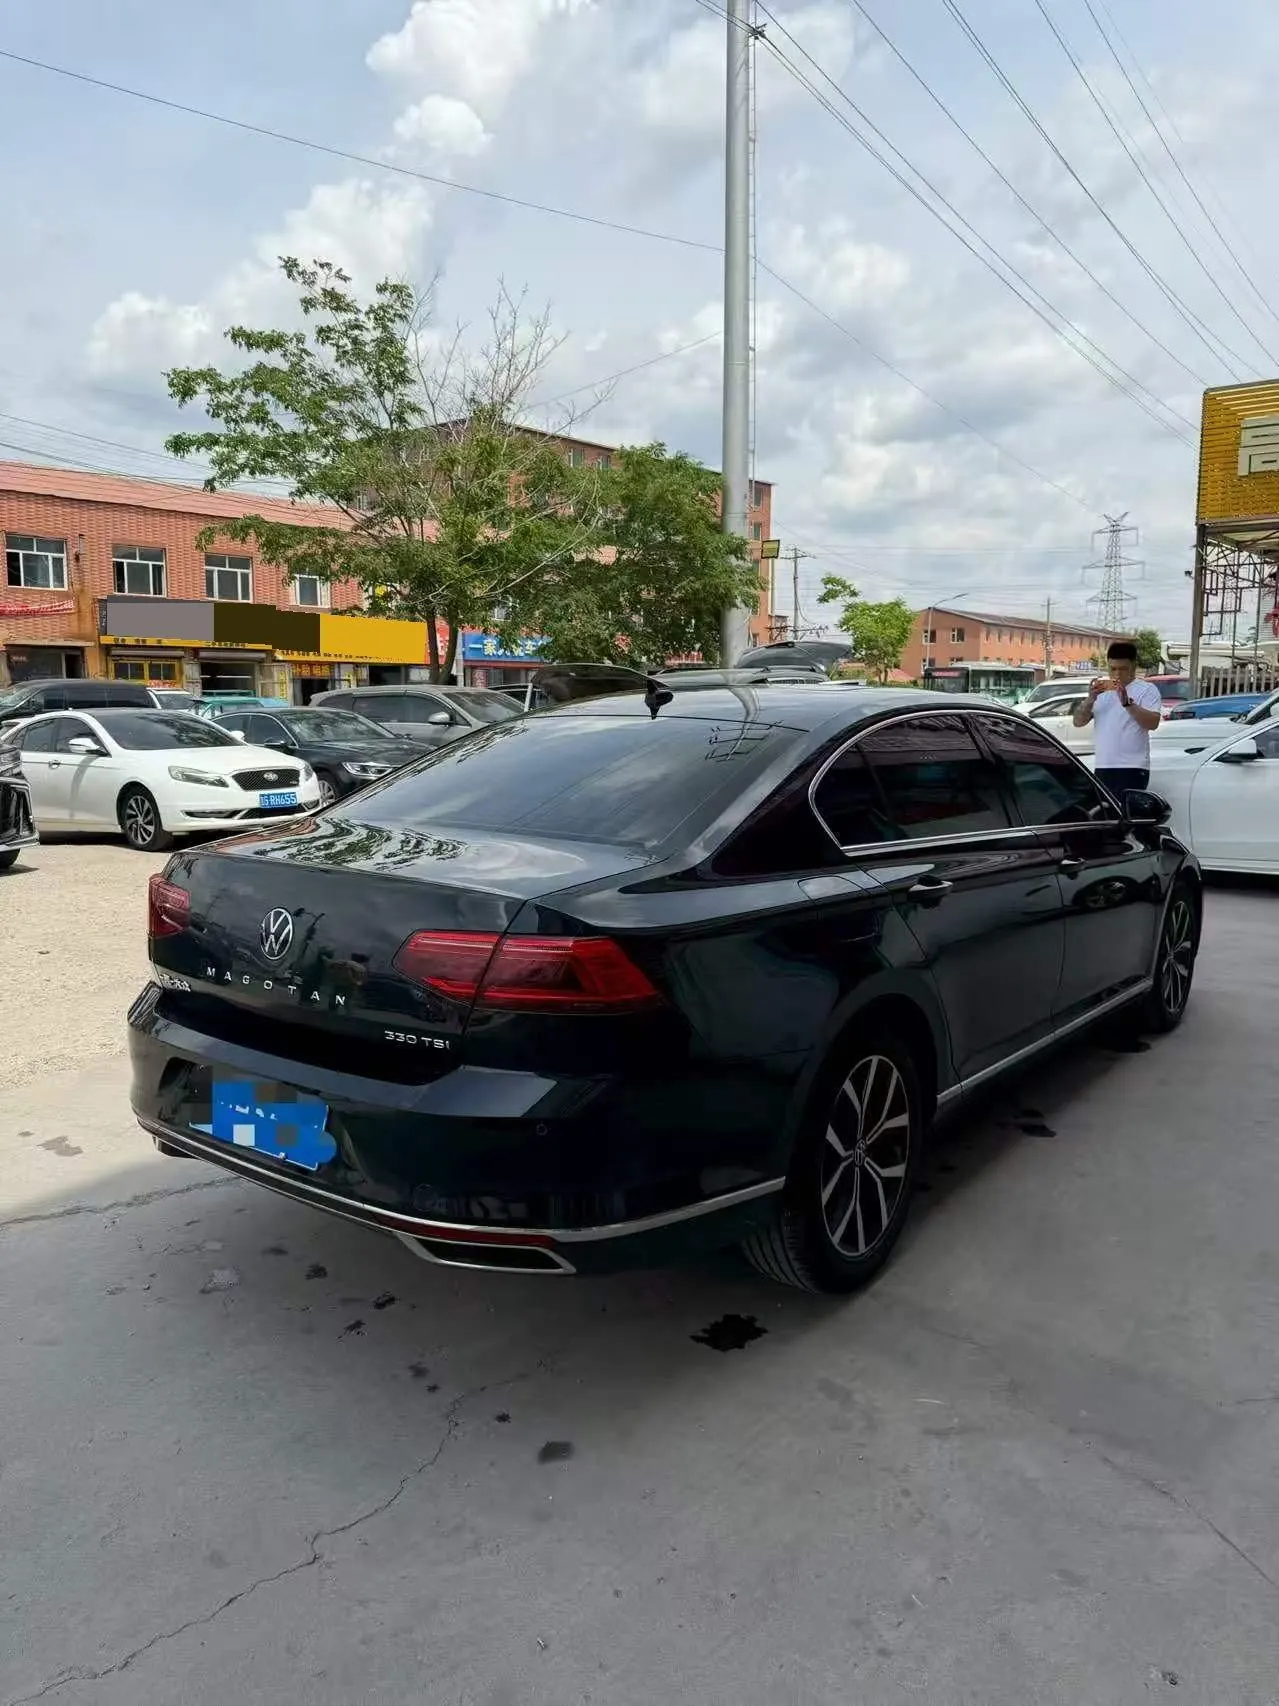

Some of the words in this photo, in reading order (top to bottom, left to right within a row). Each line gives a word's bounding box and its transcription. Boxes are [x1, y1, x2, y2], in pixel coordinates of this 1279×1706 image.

[206, 966, 346, 1005] MAGOTAN
[384, 1030, 418, 1044] 330
[421, 1036, 450, 1049] TSI
